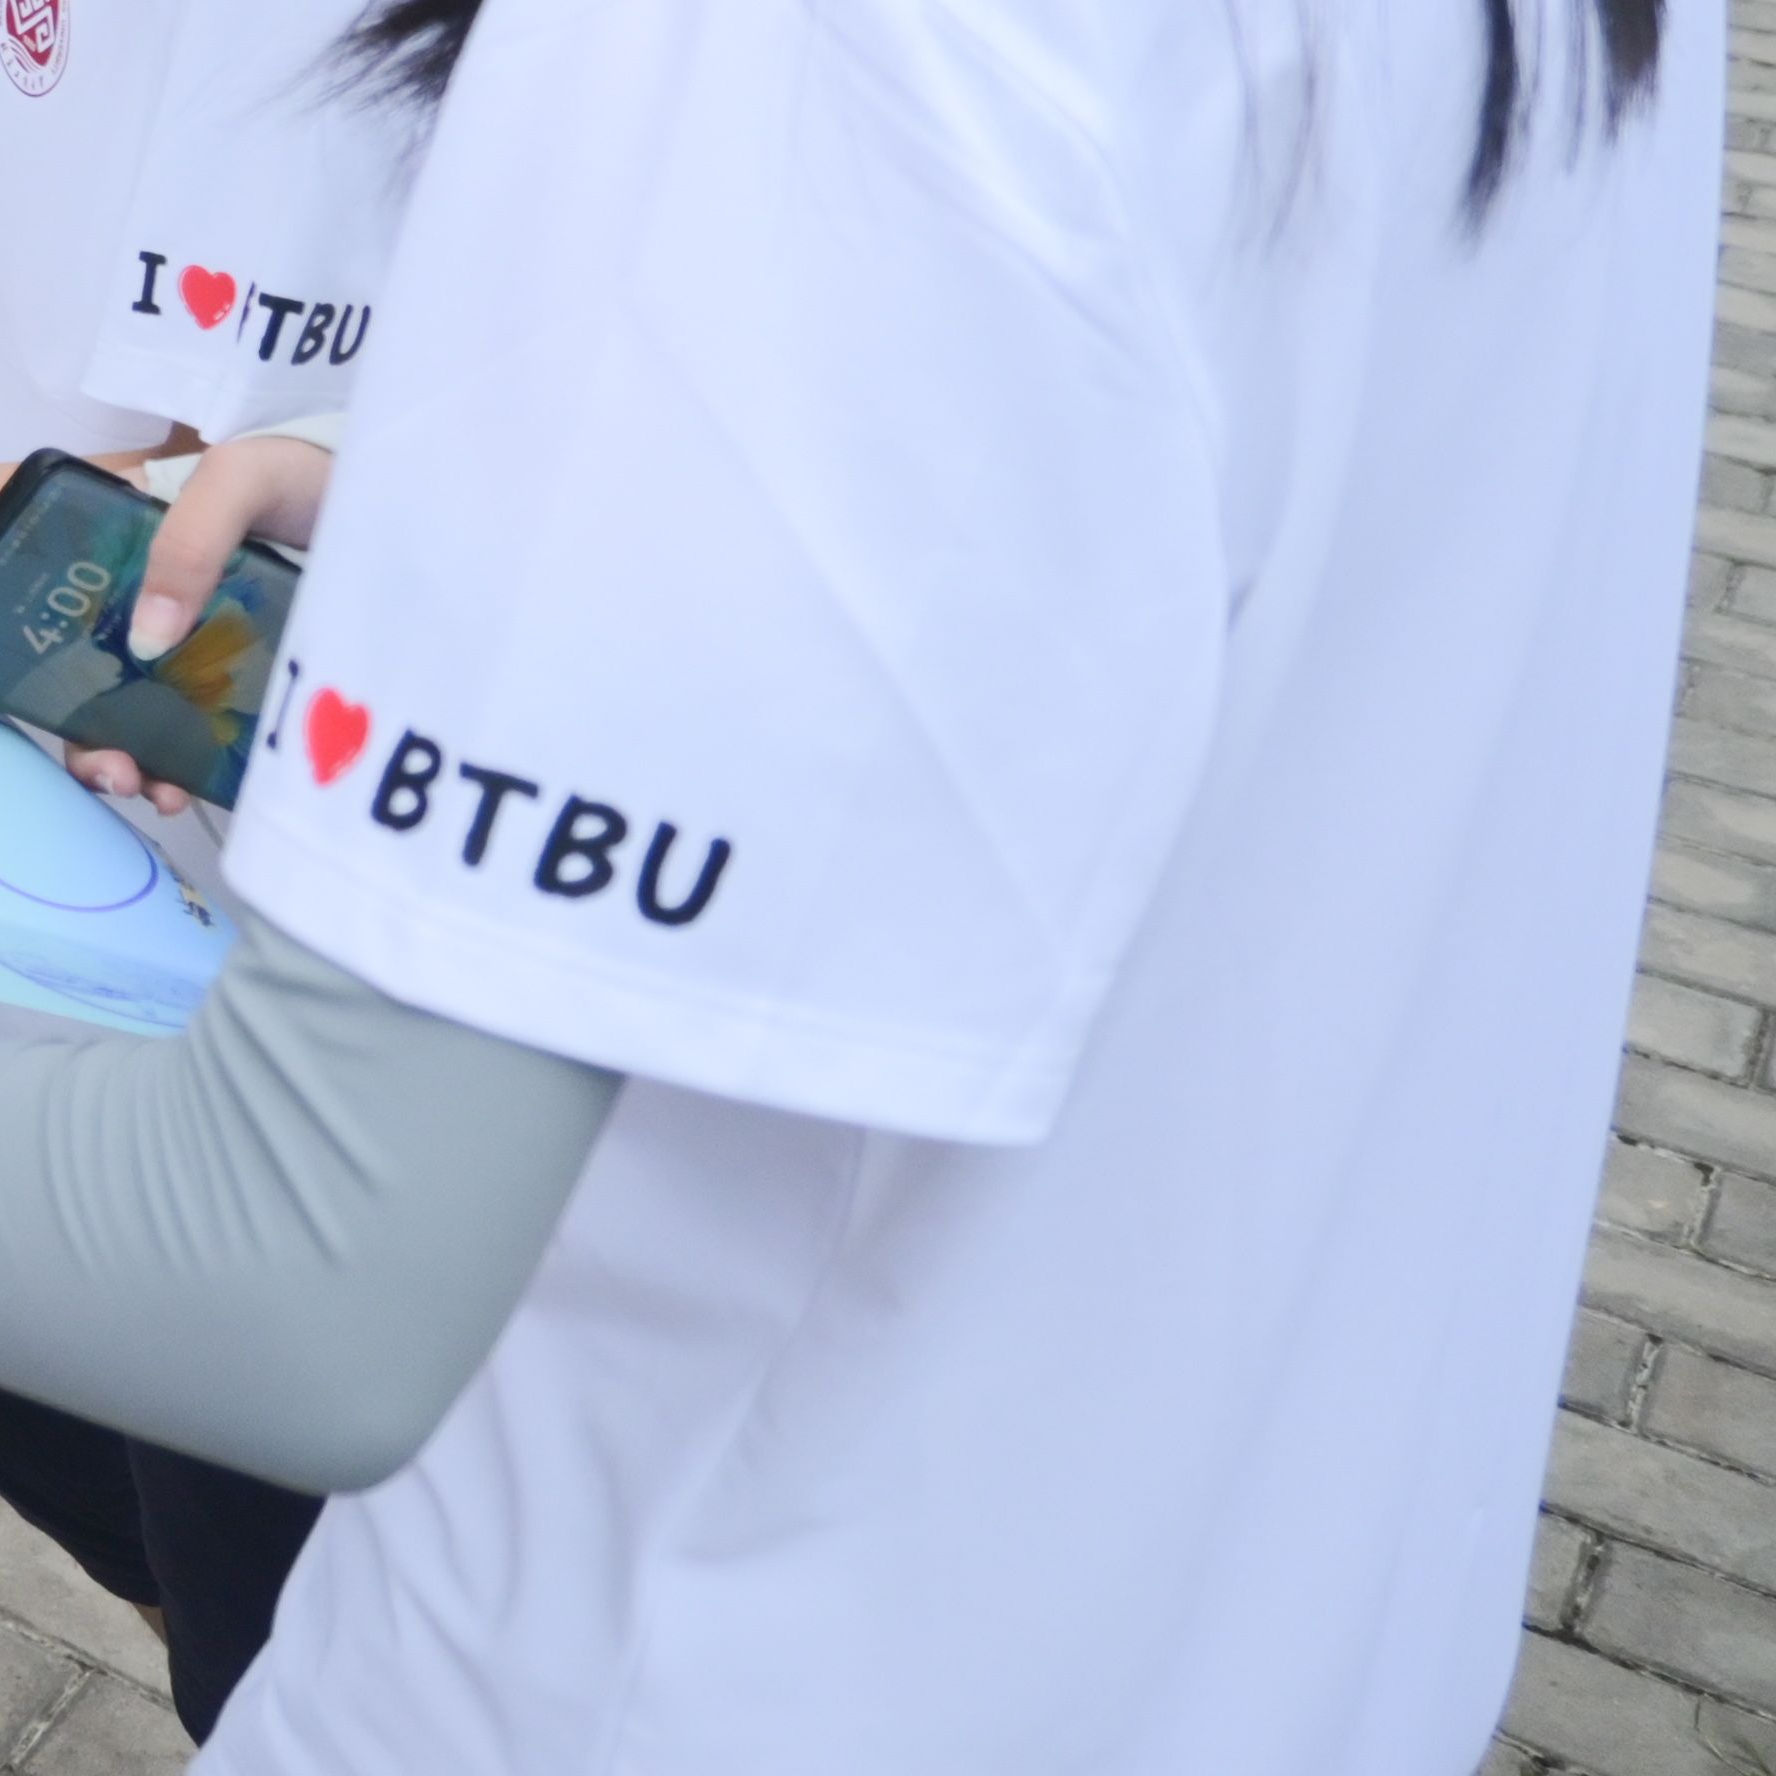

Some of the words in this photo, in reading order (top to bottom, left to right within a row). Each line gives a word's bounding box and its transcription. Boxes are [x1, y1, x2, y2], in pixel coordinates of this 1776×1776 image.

[132, 251, 167, 316] I
[236, 281, 372, 366] TBU
[22, 560, 112, 656] 4:00
[369, 727, 732, 927] BTBU
